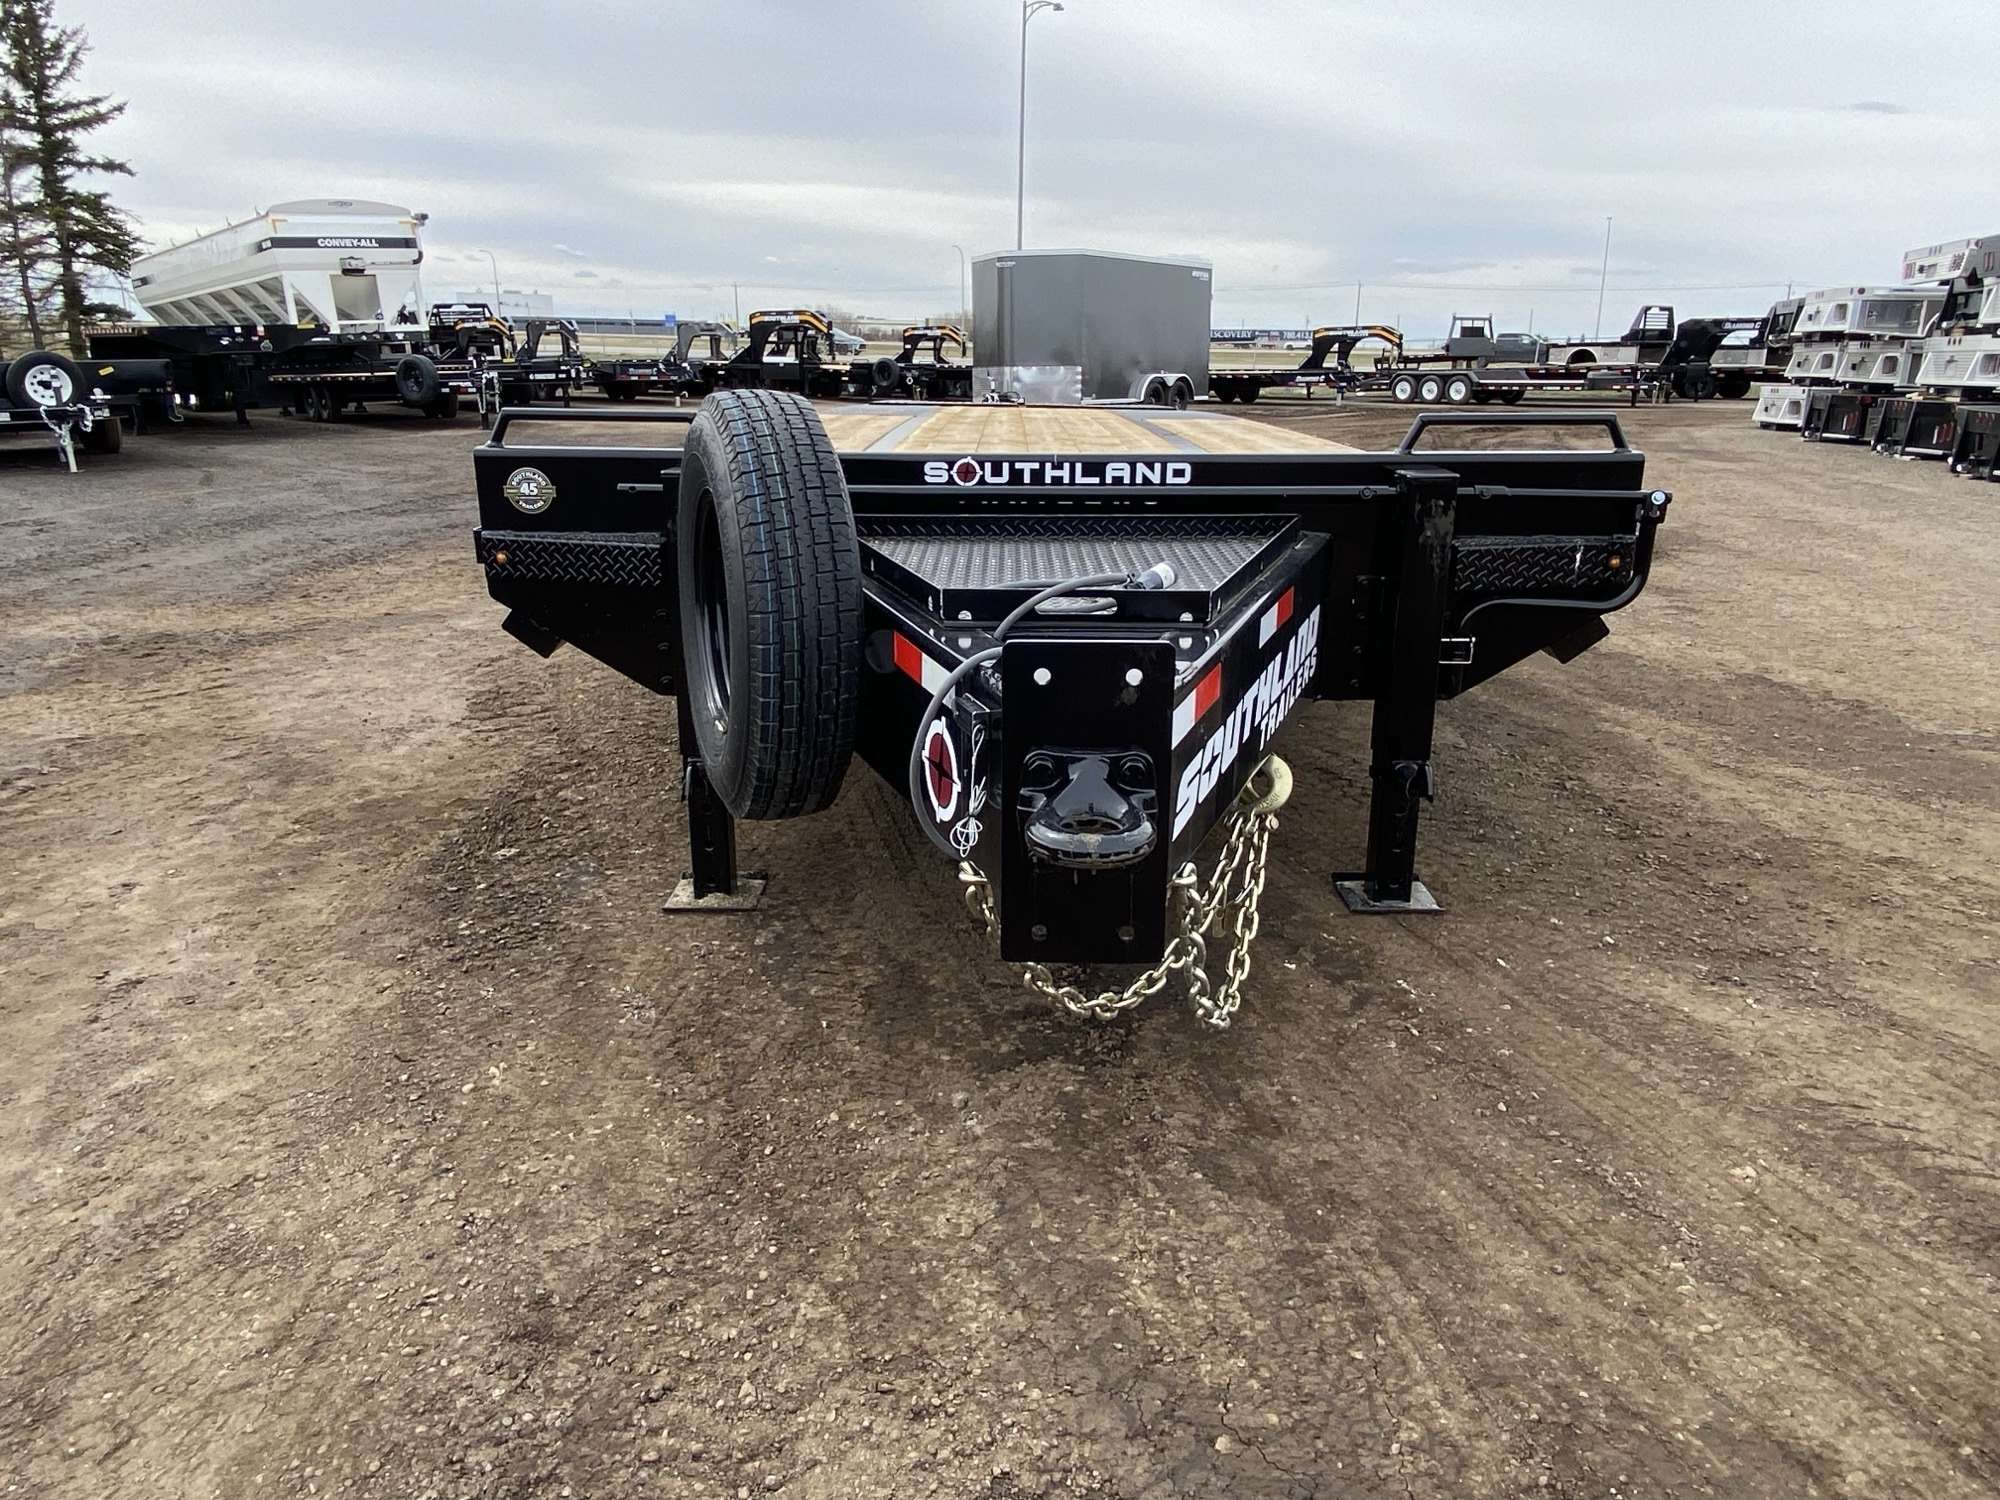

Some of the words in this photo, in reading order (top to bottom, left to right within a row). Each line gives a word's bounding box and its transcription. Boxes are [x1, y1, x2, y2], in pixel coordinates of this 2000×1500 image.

[317, 238, 379, 248] CONVEY-ALL
[1210, 330, 1252, 338] ISCOVERY
[511, 471, 547, 486] SOUTHLAND
[923, 456, 1192, 487] SOUTHLAND
[519, 482, 538, 496] 45
[1259, 646, 1318, 753] TRAILERS
[1171, 604, 1321, 843] SOUTHLAND
